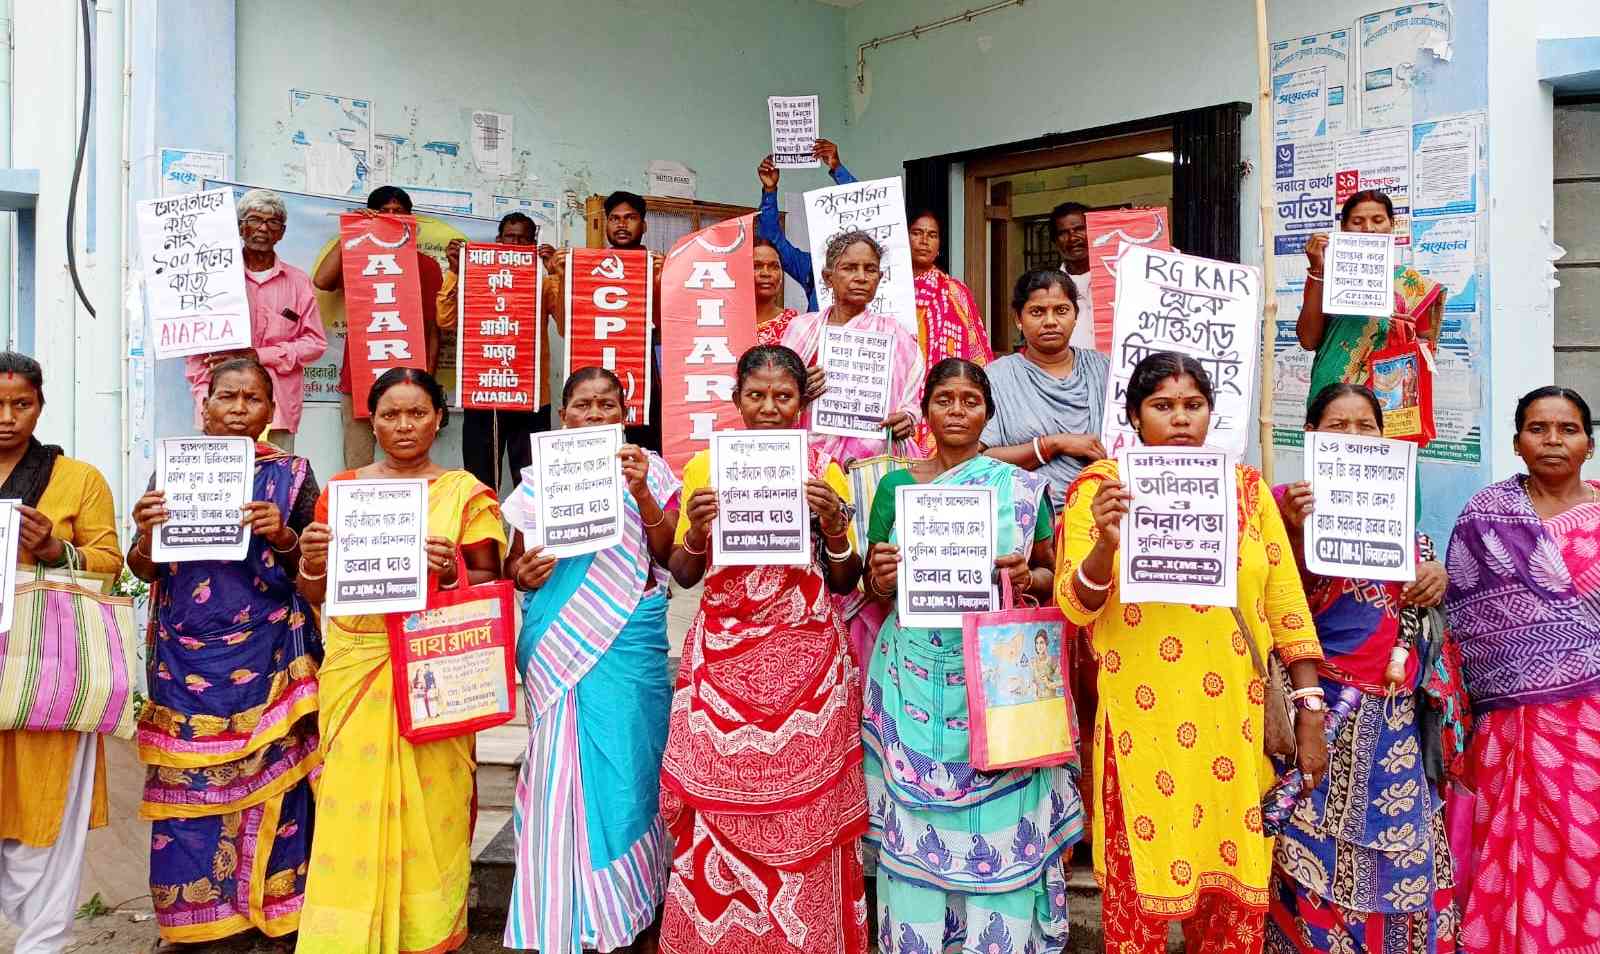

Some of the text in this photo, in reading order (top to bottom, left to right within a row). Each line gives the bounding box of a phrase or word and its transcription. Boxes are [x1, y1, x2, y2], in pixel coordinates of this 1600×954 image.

[839, 204, 884, 223] ছাড়া
[152, 243, 234, 275] ১০০ দিনের
[469, 249, 534, 267] সারা ভারত
[488, 269, 514, 294] কৃষি
[1195, 264, 1251, 296] KAR
[495, 296, 505, 312] ও
[1159, 287, 1230, 316] থেকে
[160, 318, 234, 347] AIARLA
[479, 315, 520, 336] গ্রামীণ
[481, 344, 517, 367] মজুর
[478, 368, 520, 388] সমিতি
[471, 391, 528, 405] (AIARLA)
[180, 442, 228, 452] হাসপাতালে
[1319, 442, 1390, 456] ১৪ আগস্ট
[1134, 456, 1218, 467] মহিলাদের
[1364, 464, 1405, 481] হাসপাতালে
[575, 477, 613, 491] কমিশনার
[1135, 471, 1220, 500] অধিকার
[721, 485, 797, 504] পুলিশ কমিশনার
[1330, 489, 1353, 505] হামলা
[1356, 492, 1369, 507] হল
[550, 498, 609, 518] জবাব দাও
[1169, 500, 1191, 510] ও
[727, 510, 793, 523] জবাব দাও
[1134, 505, 1224, 534] নিরাপত্তা
[1337, 516, 1362, 536] সরকার
[371, 532, 416, 546] কমিশনার
[1137, 533, 1221, 553] সুনিশ্চিত কর
[908, 542, 987, 561] পুলিশ কমিশনার
[344, 556, 411, 573] জবাব দাও
[913, 569, 982, 584] জবাব দাও
[447, 621, 492, 652] ব্রাদার্স
